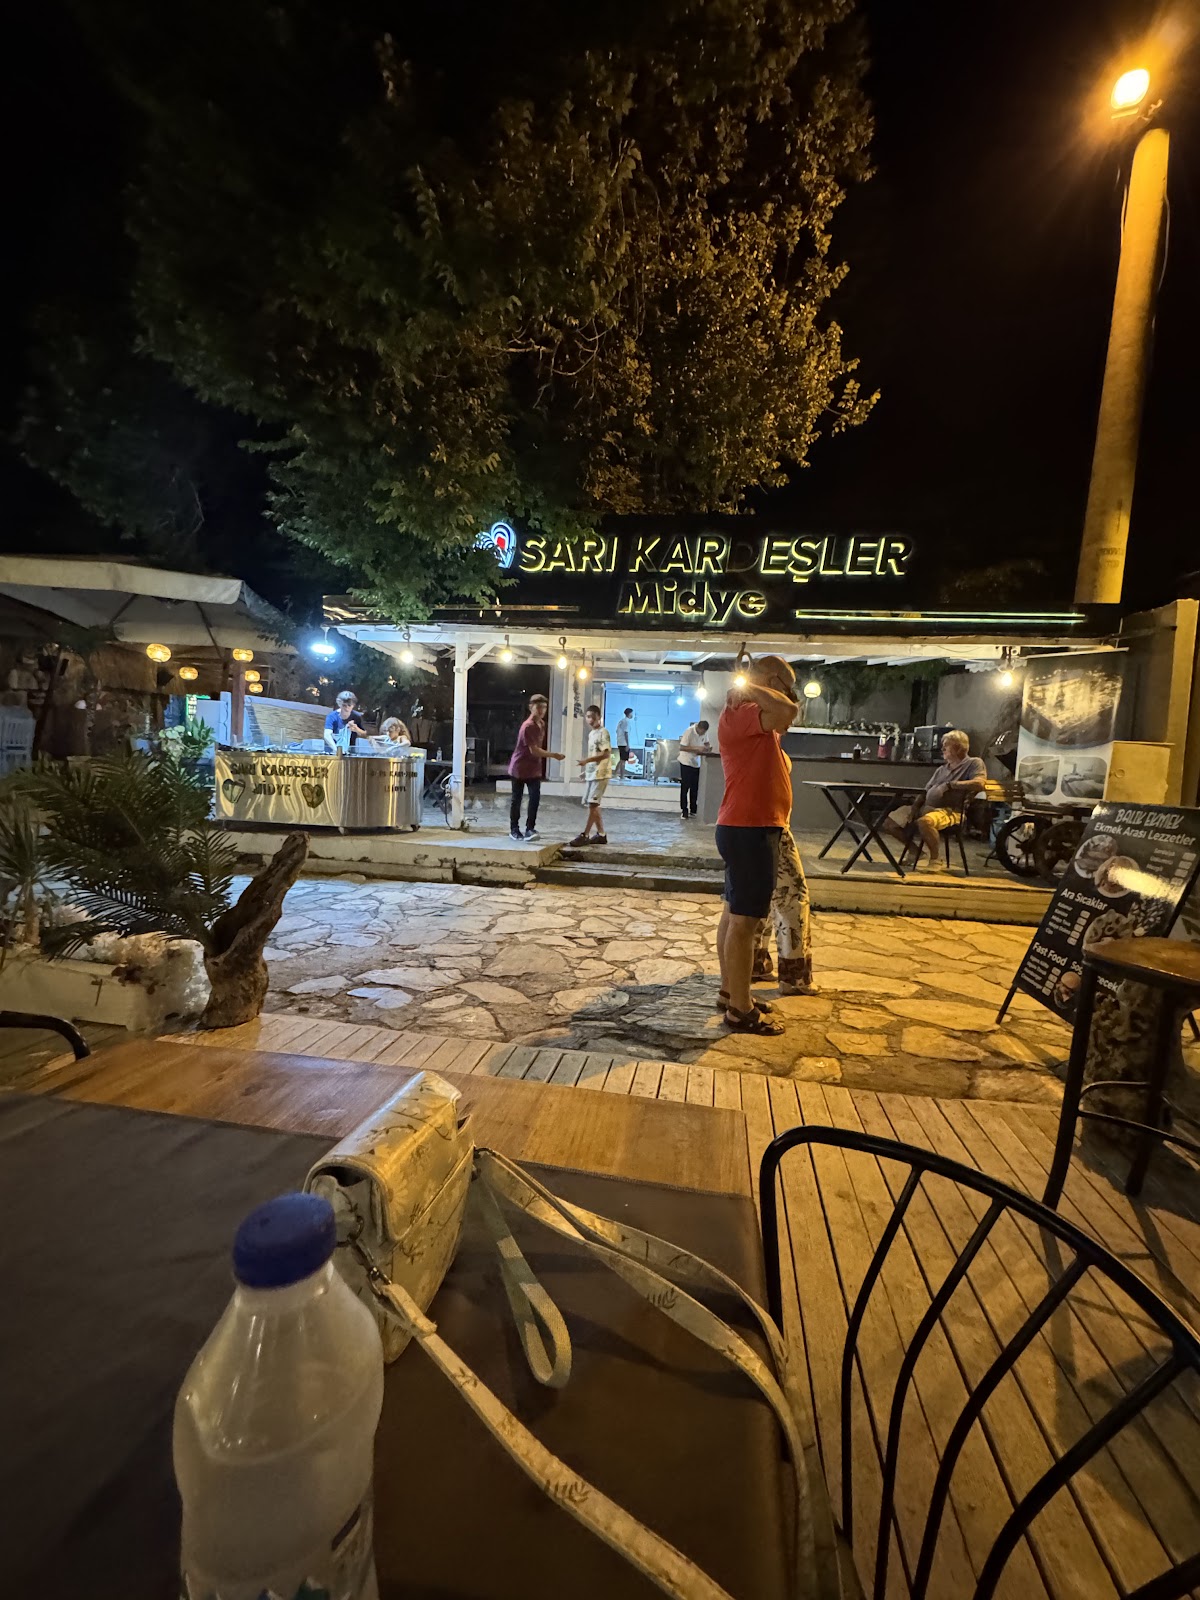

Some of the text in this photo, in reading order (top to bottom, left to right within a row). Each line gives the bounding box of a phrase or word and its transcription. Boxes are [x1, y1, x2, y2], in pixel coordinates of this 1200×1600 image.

[518, 534, 913, 584] SARI KARDEŞLER
[617, 579, 769, 624] Midye
[230, 763, 329, 781] SARI KARDEŞLER
[1094, 822, 1197, 846] Ekmek Arası Lezzetler
[1061, 888, 1075, 900] Ara
[1074, 892, 1108, 911] Sıcaklar
[1032, 942, 1049, 957] Fast
[1047, 949, 1069, 966] Food
